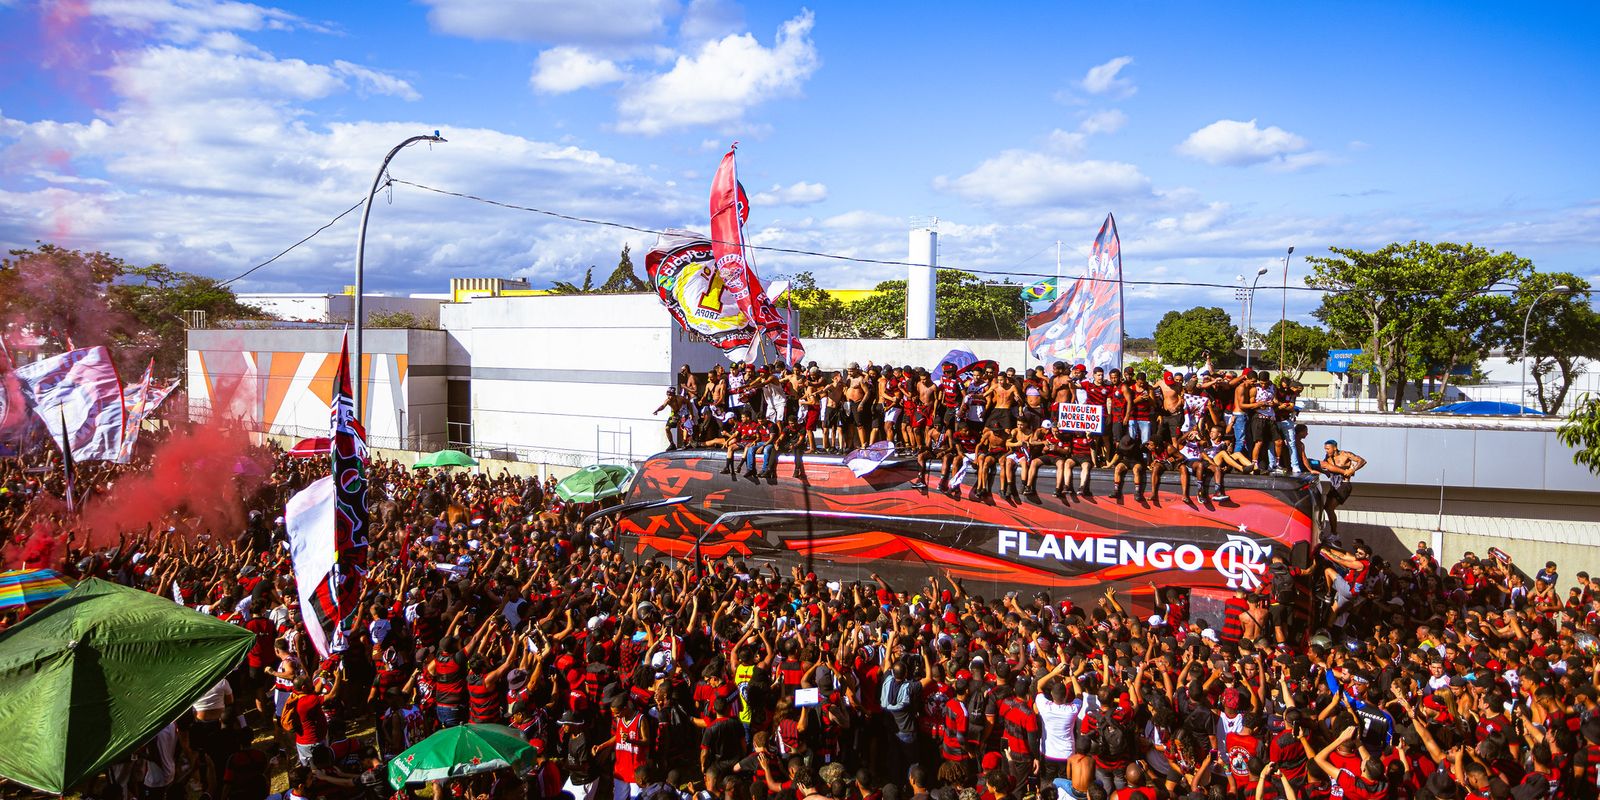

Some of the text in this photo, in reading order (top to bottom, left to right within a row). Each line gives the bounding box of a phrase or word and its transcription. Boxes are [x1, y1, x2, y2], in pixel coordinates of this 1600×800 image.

[1061, 412, 1100, 422] MORRE NOS
[1062, 420, 1099, 431] DEVENDO!
[998, 530, 1204, 571] FLAMENGO
